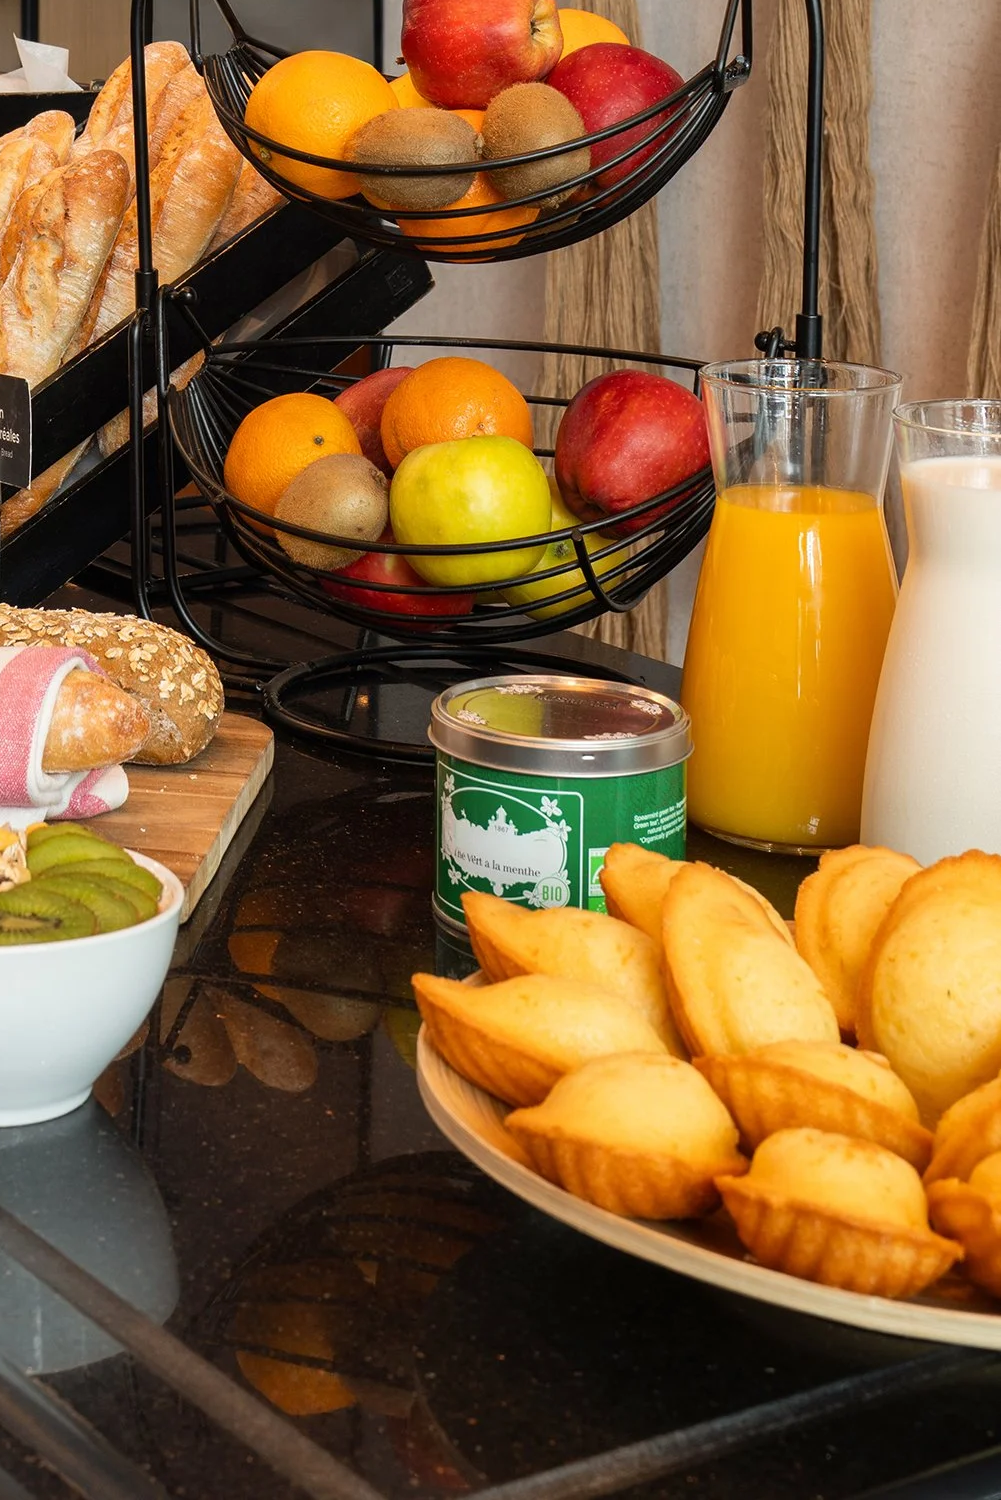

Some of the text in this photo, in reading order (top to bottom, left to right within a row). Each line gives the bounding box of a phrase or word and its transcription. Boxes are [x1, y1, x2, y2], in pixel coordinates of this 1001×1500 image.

[1, 447, 13, 459] Bread
[493, 824, 509, 833] 1867
[633, 822, 649, 830] Green
[492, 859, 501, 871] la
[502, 864, 541, 877] menthe
[542, 885, 562, 901] BIO
